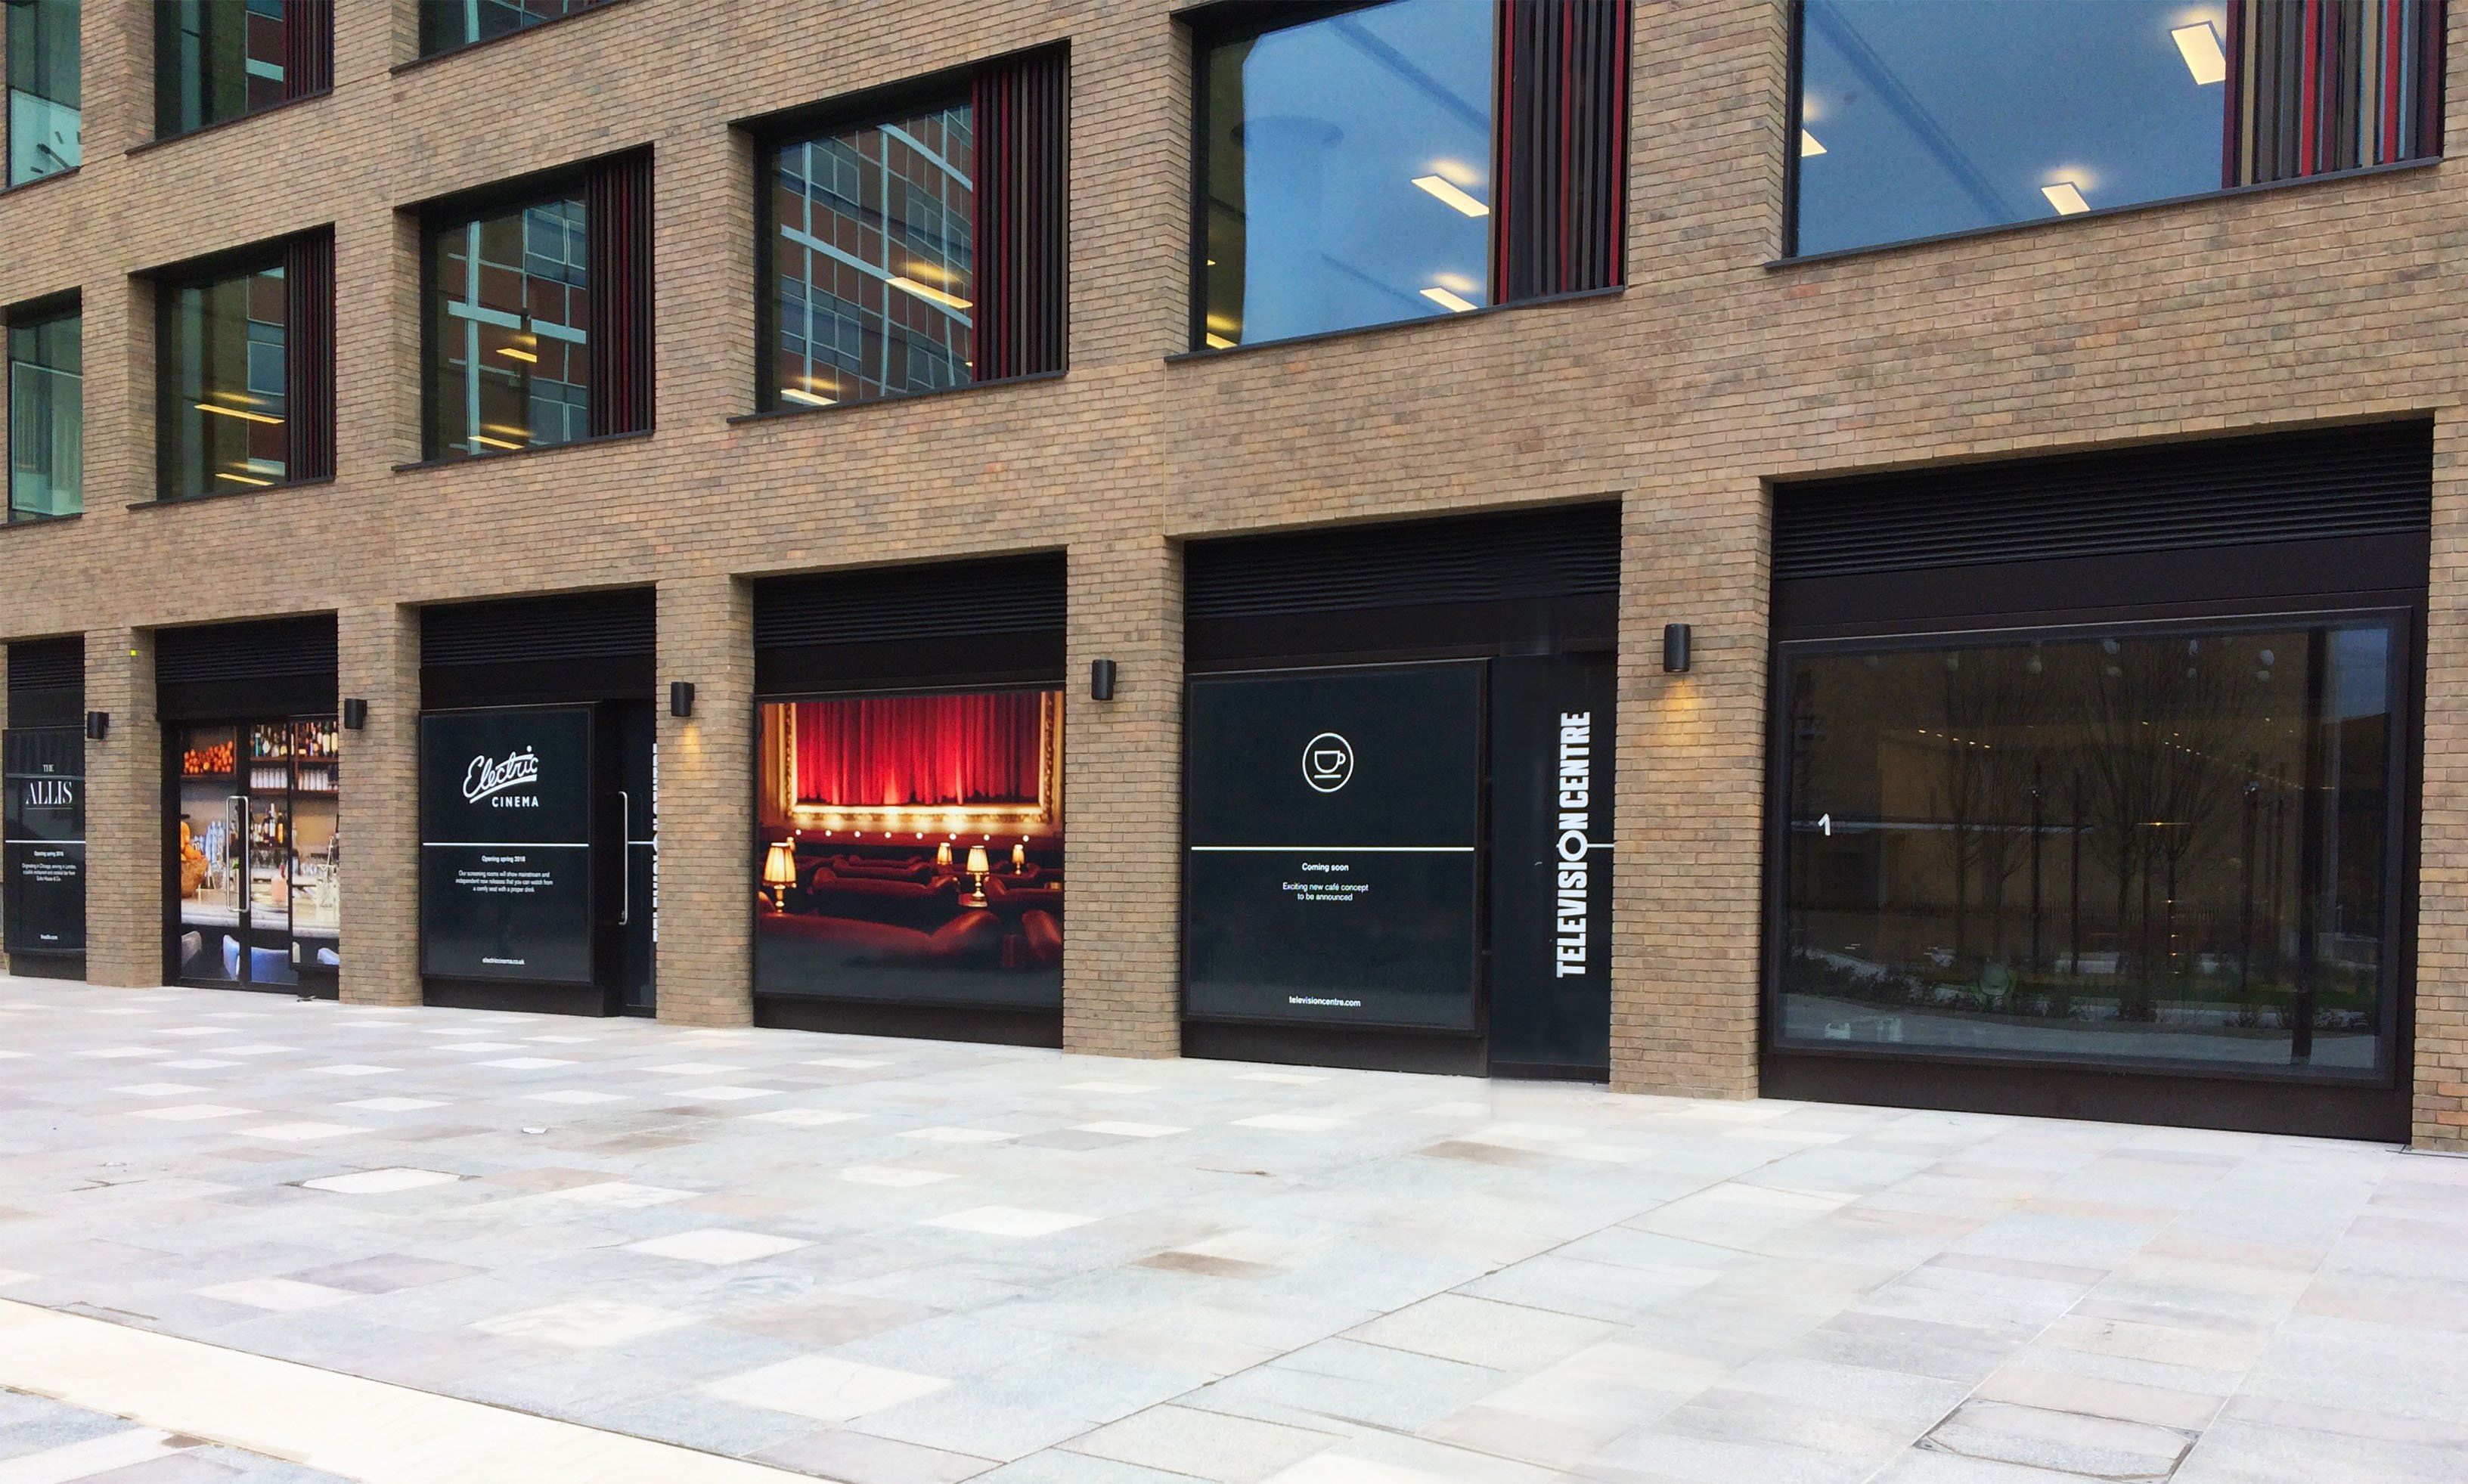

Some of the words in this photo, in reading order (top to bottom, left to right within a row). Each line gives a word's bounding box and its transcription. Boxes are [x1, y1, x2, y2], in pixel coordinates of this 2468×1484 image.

[1559, 711, 1591, 808] CENTRE
[42, 764, 54, 772] THE
[463, 745, 539, 798] Electric
[25, 780, 73, 805] ALLIS
[491, 795, 539, 807] CINEMA
[1817, 813, 1831, 836] 1
[1301, 863, 1329, 872] Coming
[1282, 881, 1308, 892] Exciting
[1325, 882, 1339, 891] café
[1341, 884, 1369, 893] concept
[1316, 893, 1353, 901] announced
[1556, 812, 1589, 978] TELEVISION
[1288, 996, 1361, 1007] televisioncentre.com
